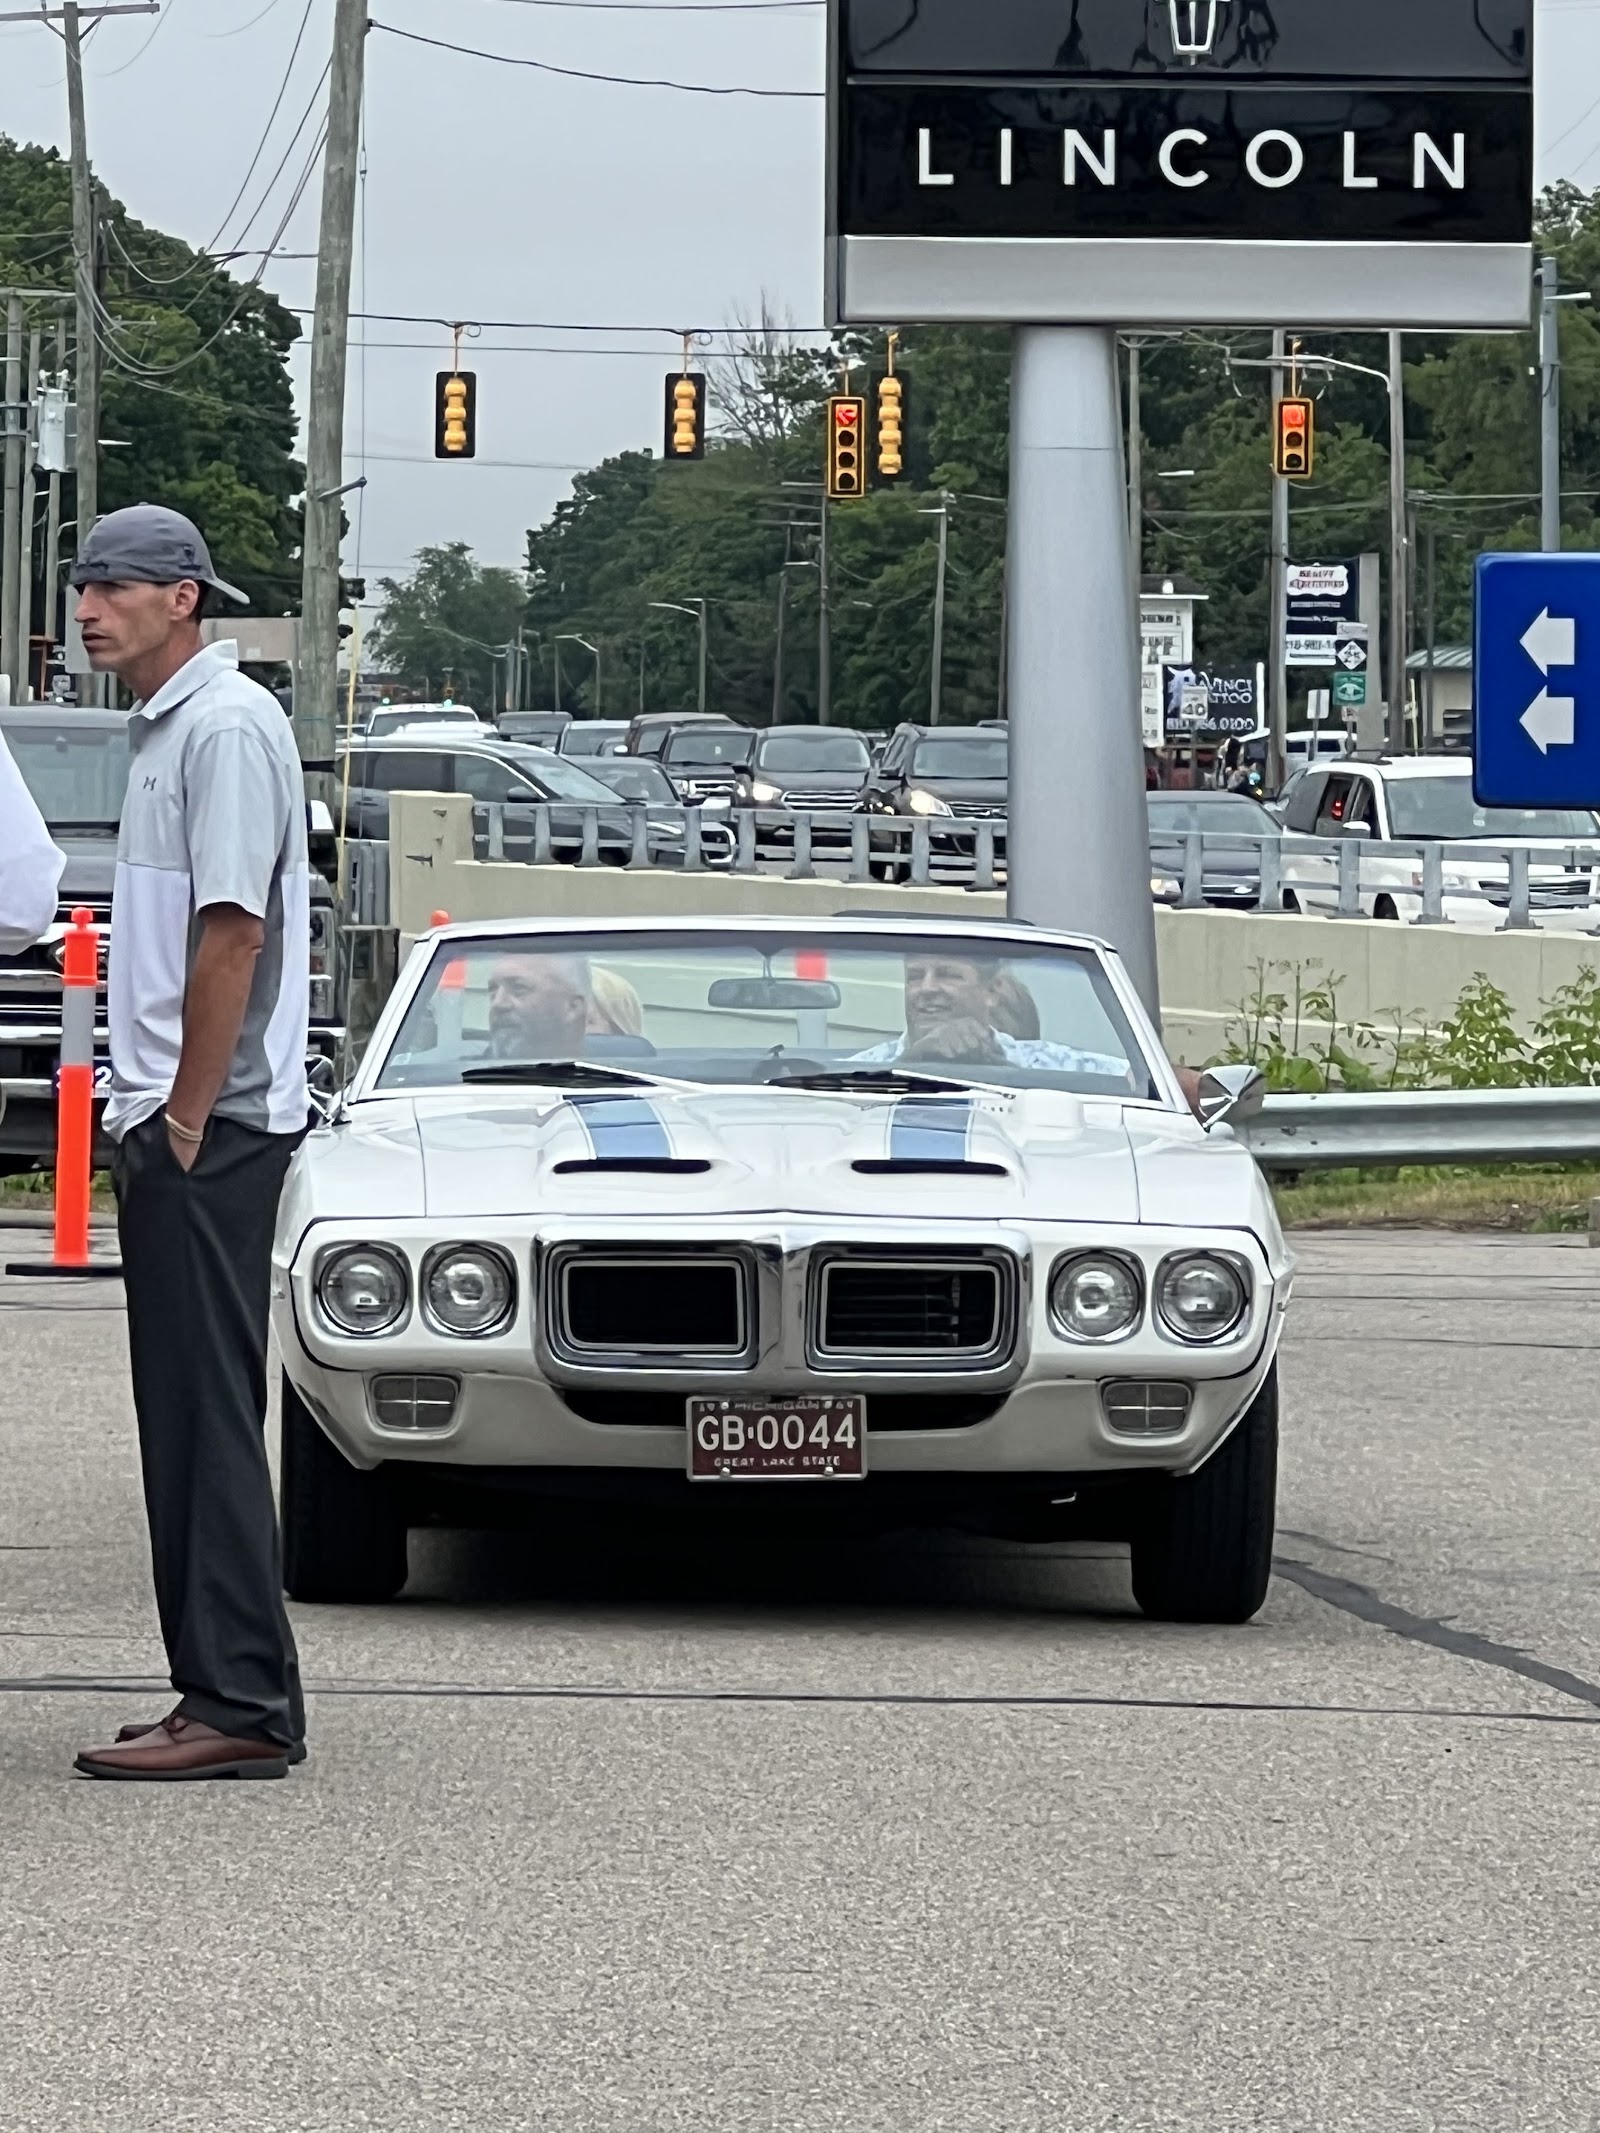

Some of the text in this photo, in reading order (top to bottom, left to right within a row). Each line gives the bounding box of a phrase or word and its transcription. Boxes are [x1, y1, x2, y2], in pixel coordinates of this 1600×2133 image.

[917, 128, 1466, 190] LINCOLN
[713, 1456, 841, 1467] GREAT LAKE STATE
